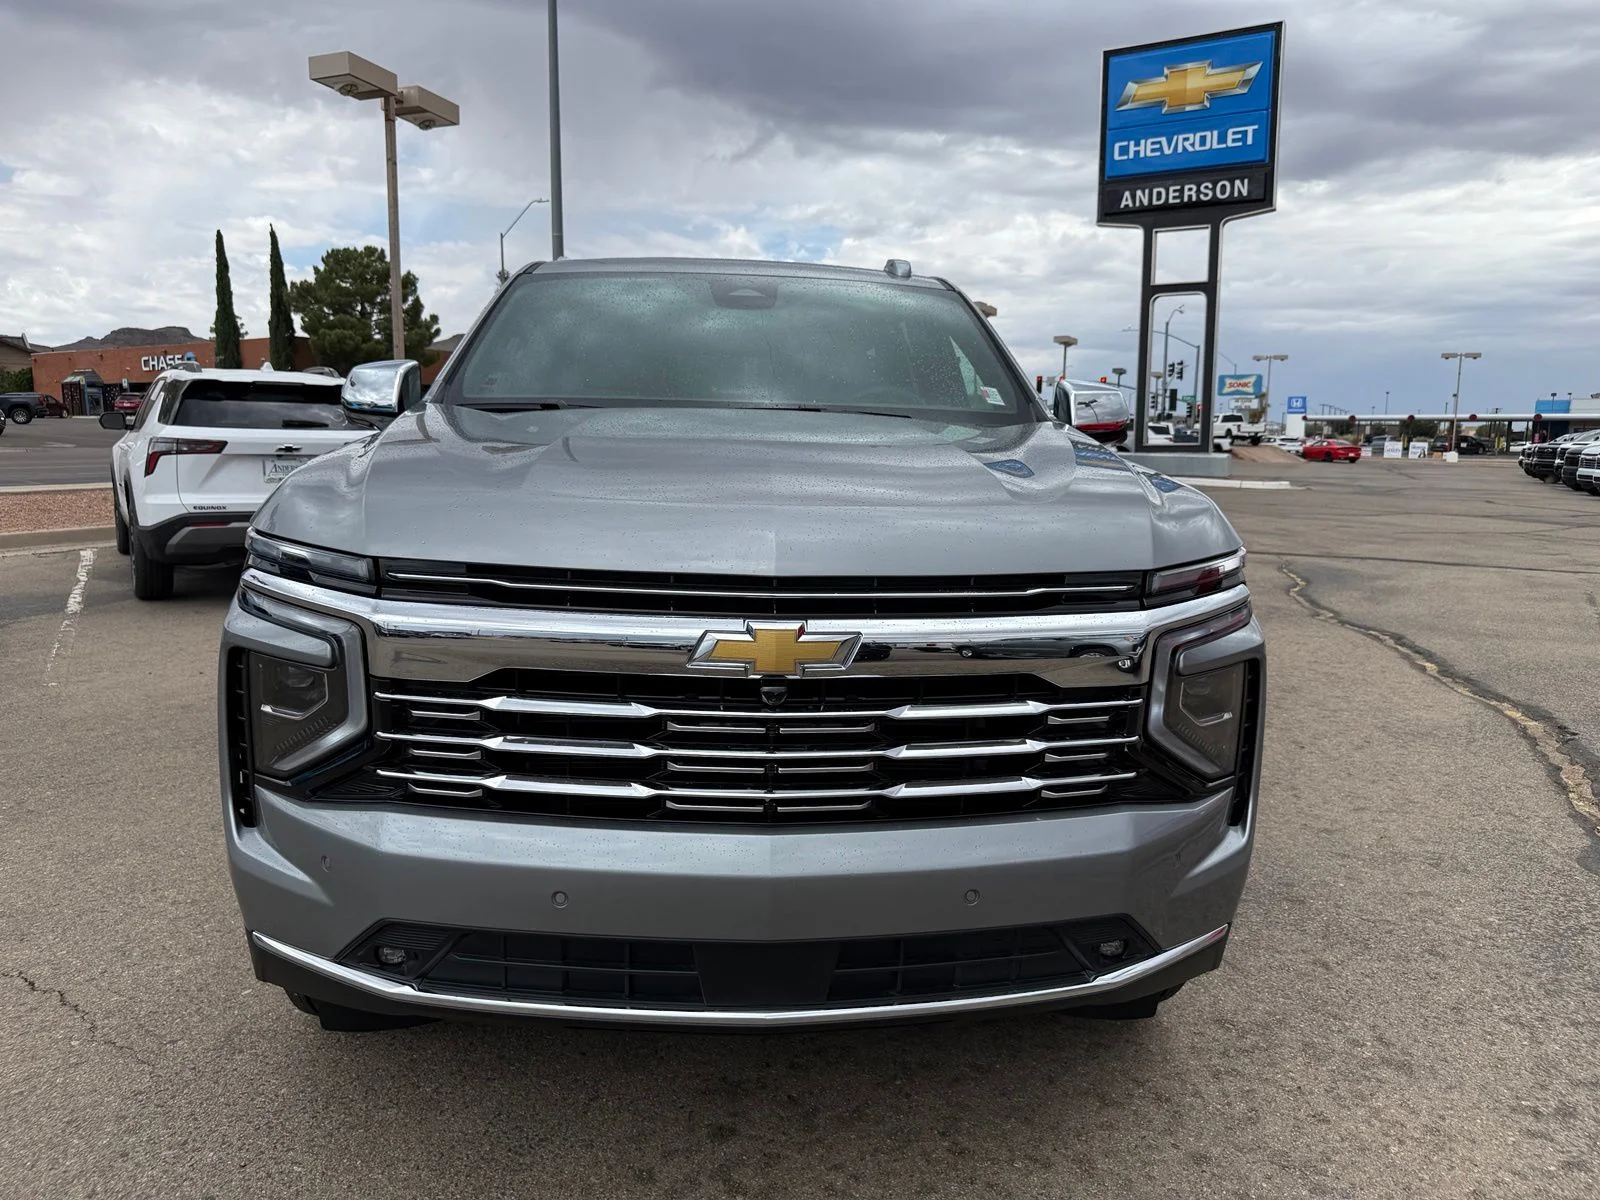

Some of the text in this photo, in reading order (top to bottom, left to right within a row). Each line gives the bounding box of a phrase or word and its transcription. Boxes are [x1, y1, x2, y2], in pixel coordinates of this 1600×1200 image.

[1113, 125, 1258, 161] CHEVROLET
[1120, 178, 1248, 209] ANDERSON
[1227, 381, 1252, 389] SONIC
